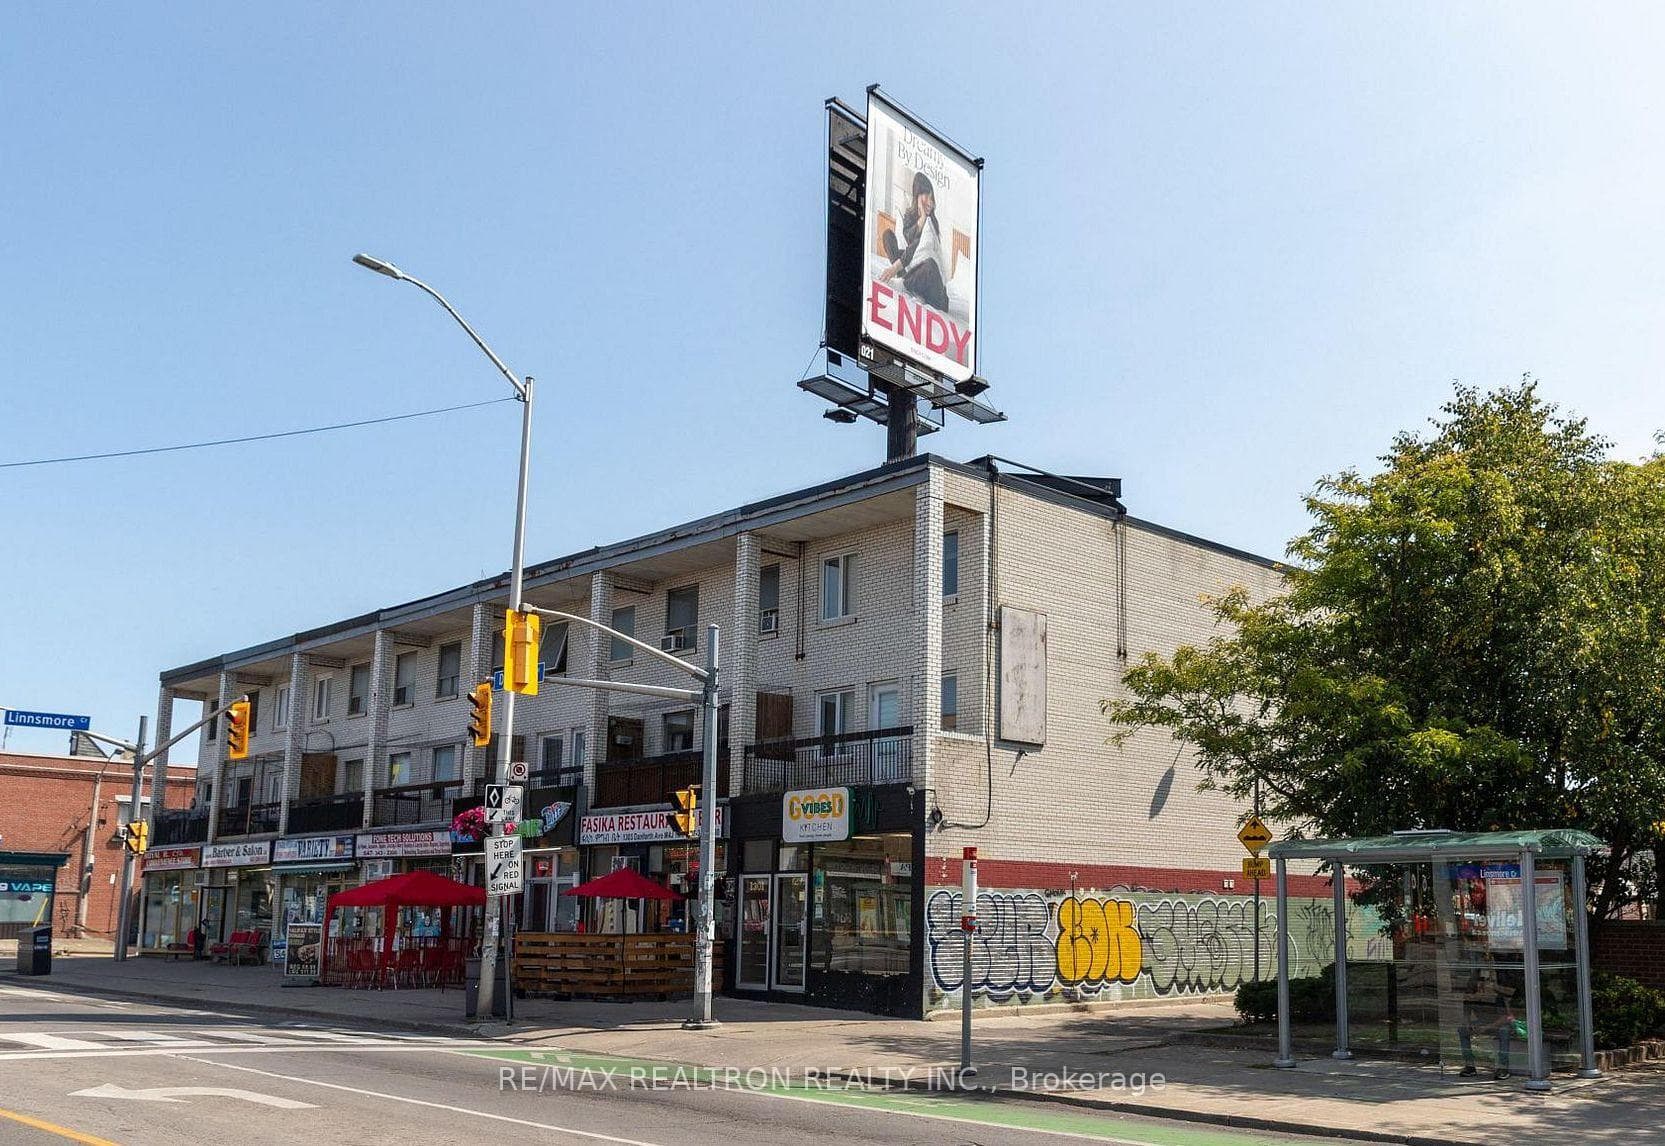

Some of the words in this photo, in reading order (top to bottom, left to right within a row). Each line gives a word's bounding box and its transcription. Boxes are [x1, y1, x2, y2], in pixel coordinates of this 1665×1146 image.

[898, 140, 912, 166] By
[914, 152, 950, 190] Design
[867, 281, 971, 365] ENDY
[861, 346, 874, 361] 021
[8, 711, 75, 727] Linnsmore
[503, 809, 515, 817] THIS
[789, 793, 844, 820] GOOD
[801, 801, 833, 815] VIBES
[581, 815, 615, 833] FASIKA
[800, 822, 832, 832] KITCHEN
[402, 831, 433, 842] SOLUTIONS
[298, 839, 330, 858] VARIETY
[494, 840, 514, 849] STOP
[212, 846, 236, 859] Barber
[235, 846, 241, 857] &
[243, 845, 262, 857] Salon
[493, 850, 514, 859] HERE
[503, 872, 519, 880] RED
[11, 883, 53, 892] VAPE
[490, 882, 519, 892] SIGNAL
